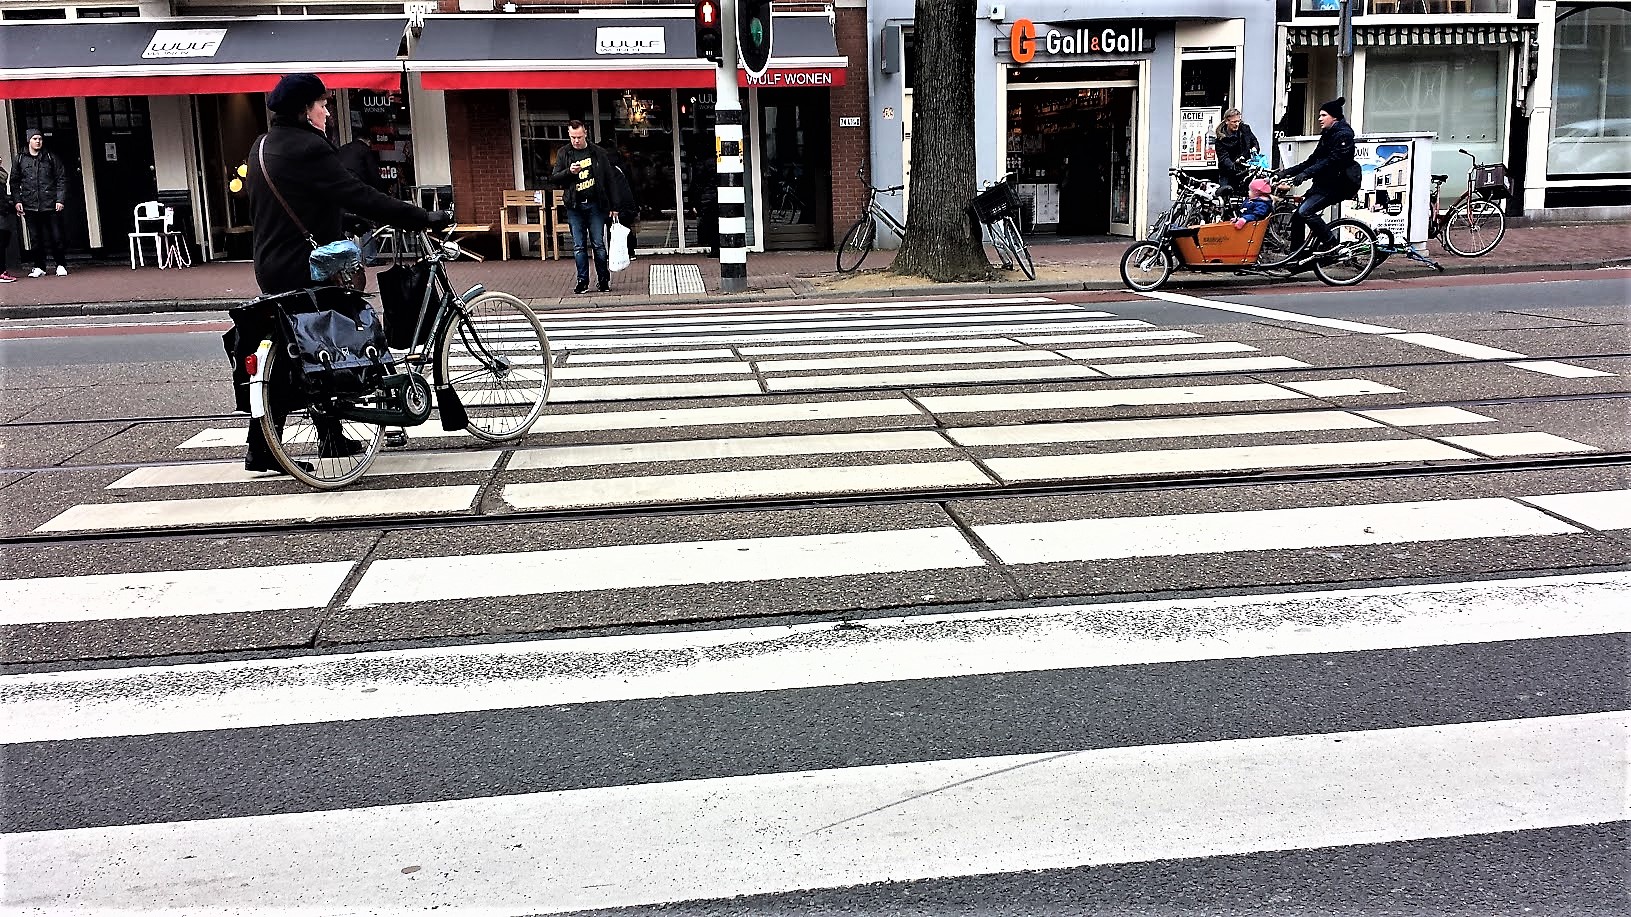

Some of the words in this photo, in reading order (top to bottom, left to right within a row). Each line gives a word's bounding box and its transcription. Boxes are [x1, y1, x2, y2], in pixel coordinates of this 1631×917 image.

[151, 42, 216, 51] WULF
[601, 40, 660, 48] WULF
[746, 73, 782, 85] WULF
[784, 72, 832, 85] WONEN
[363, 95, 395, 106] WULF
[1183, 112, 1204, 120] ACTIE!
[1274, 130, 1285, 139] 70
[379, 165, 398, 179] ale
